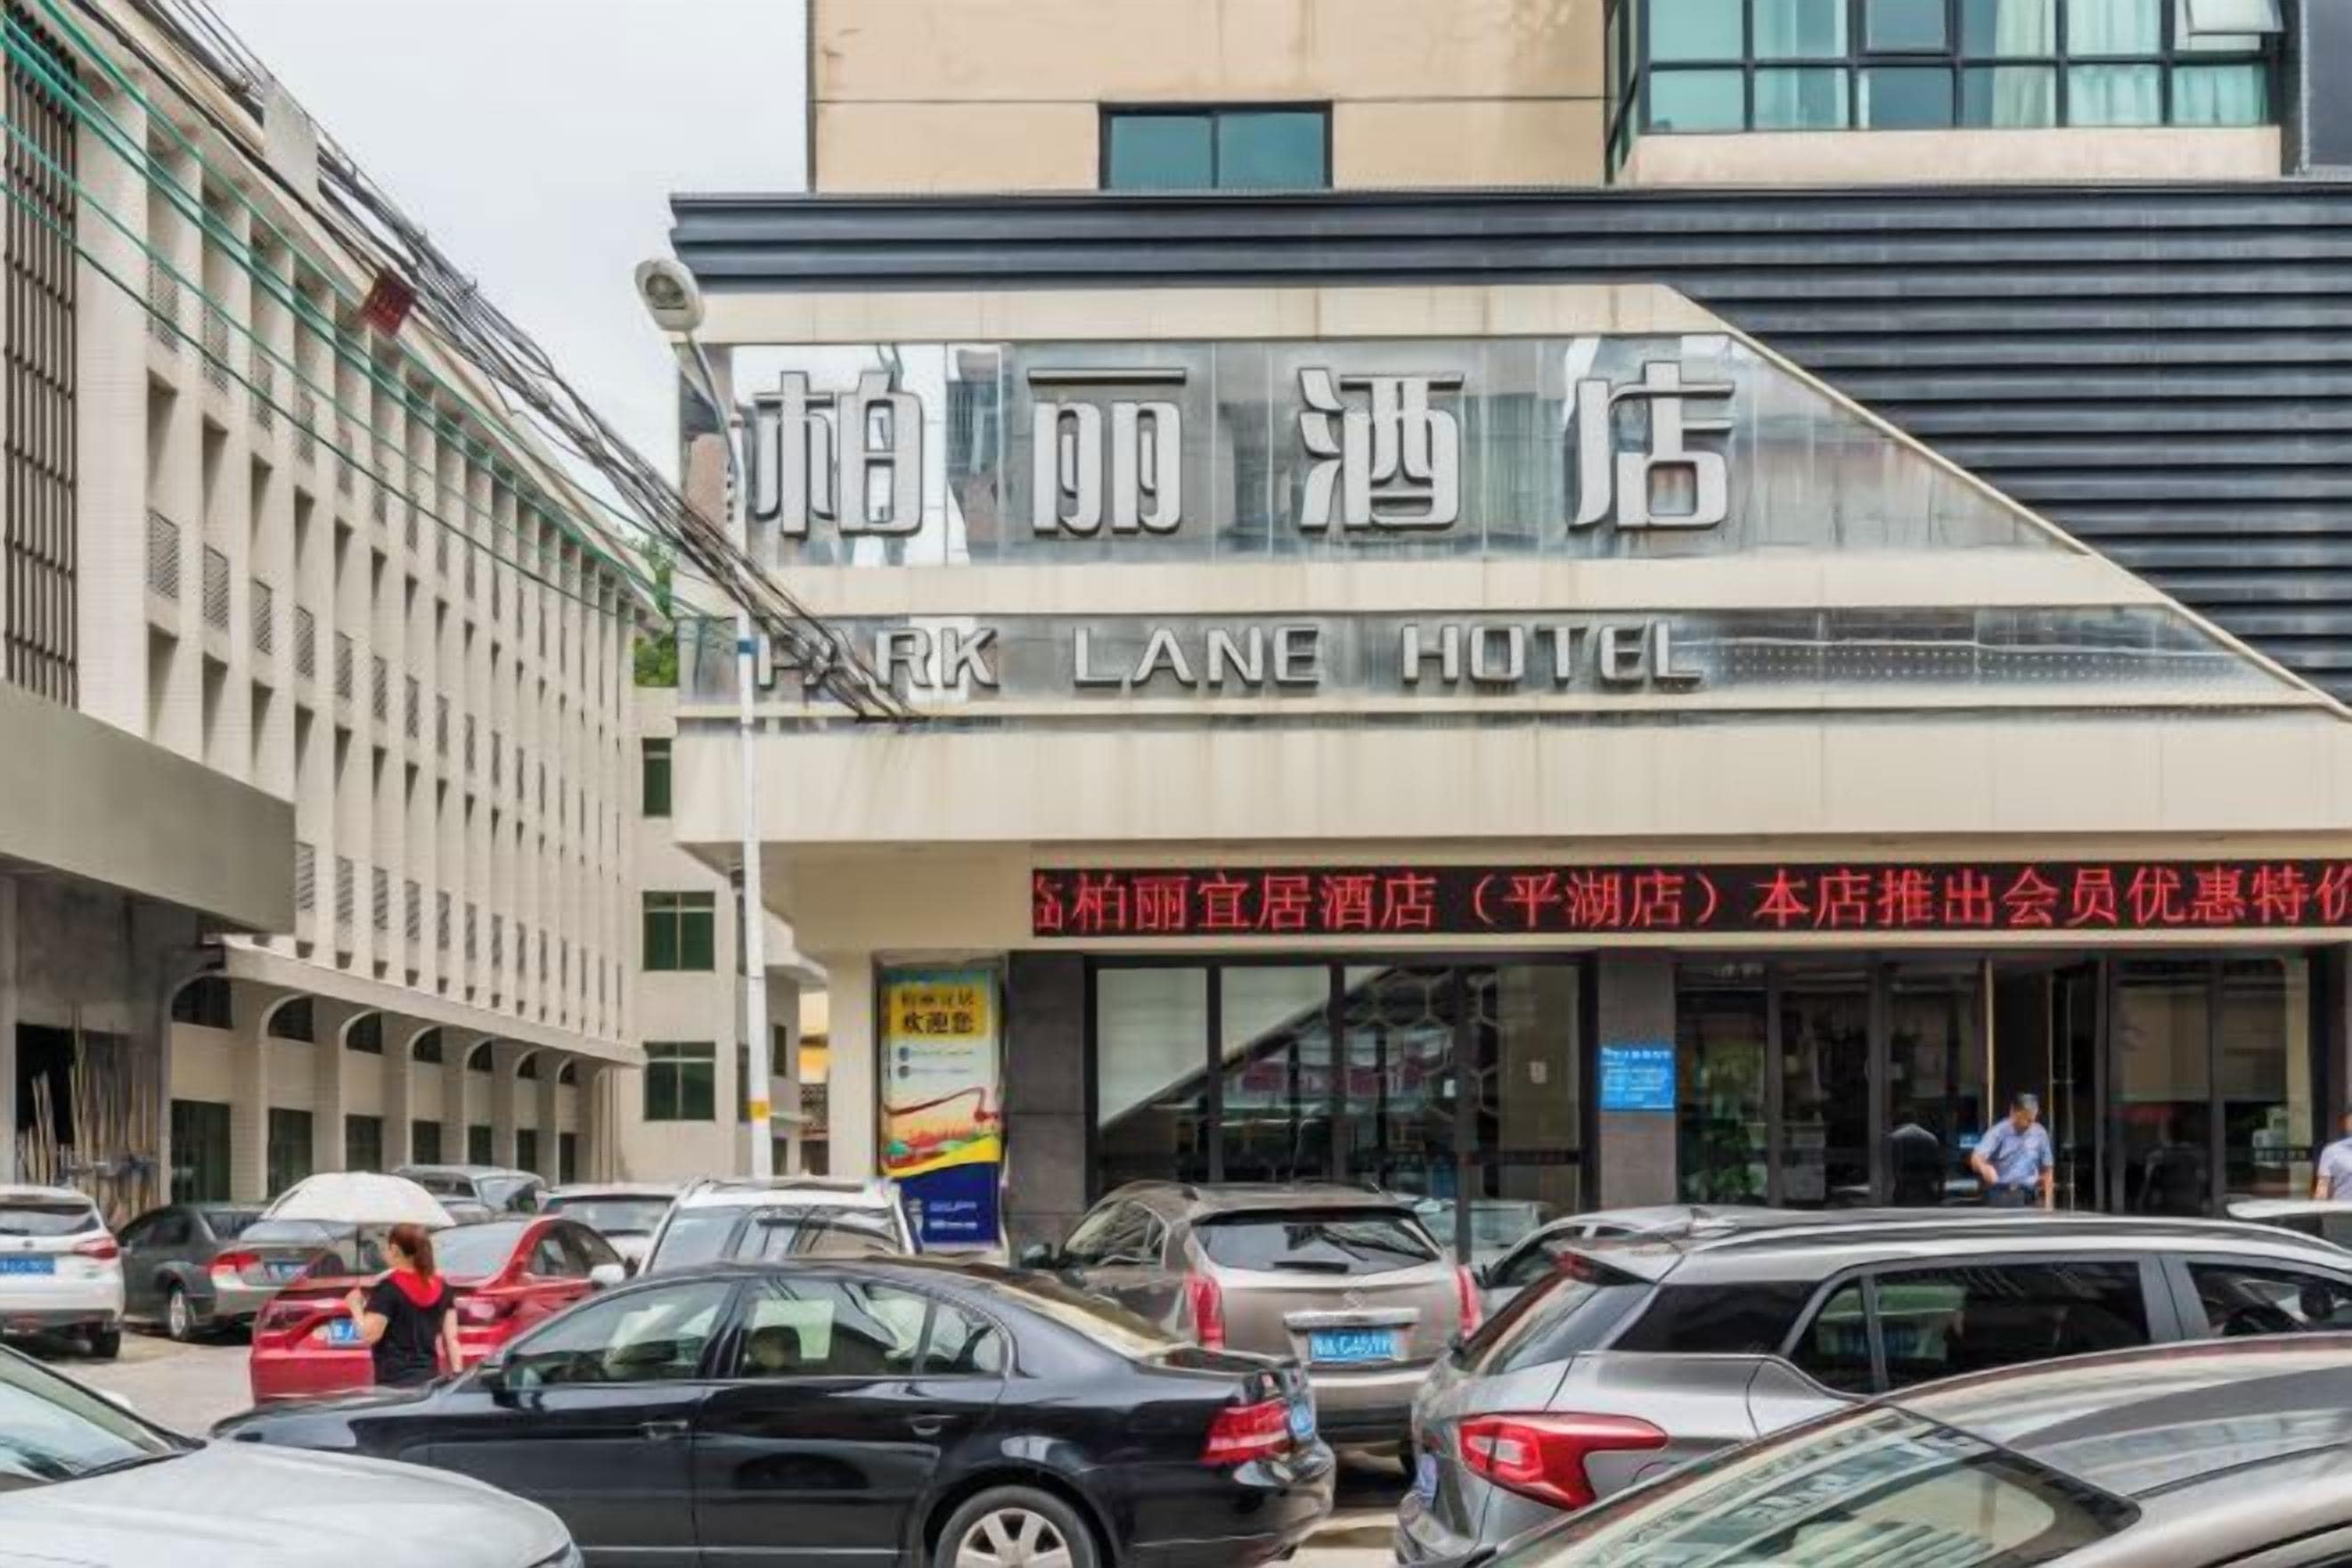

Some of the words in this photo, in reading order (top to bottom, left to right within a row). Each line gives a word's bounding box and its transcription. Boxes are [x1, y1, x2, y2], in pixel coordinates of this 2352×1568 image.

[754, 360, 1735, 537] 柏丽酒店
[1074, 625, 1321, 688] LANE
[1401, 622, 1703, 688] HOTEL
